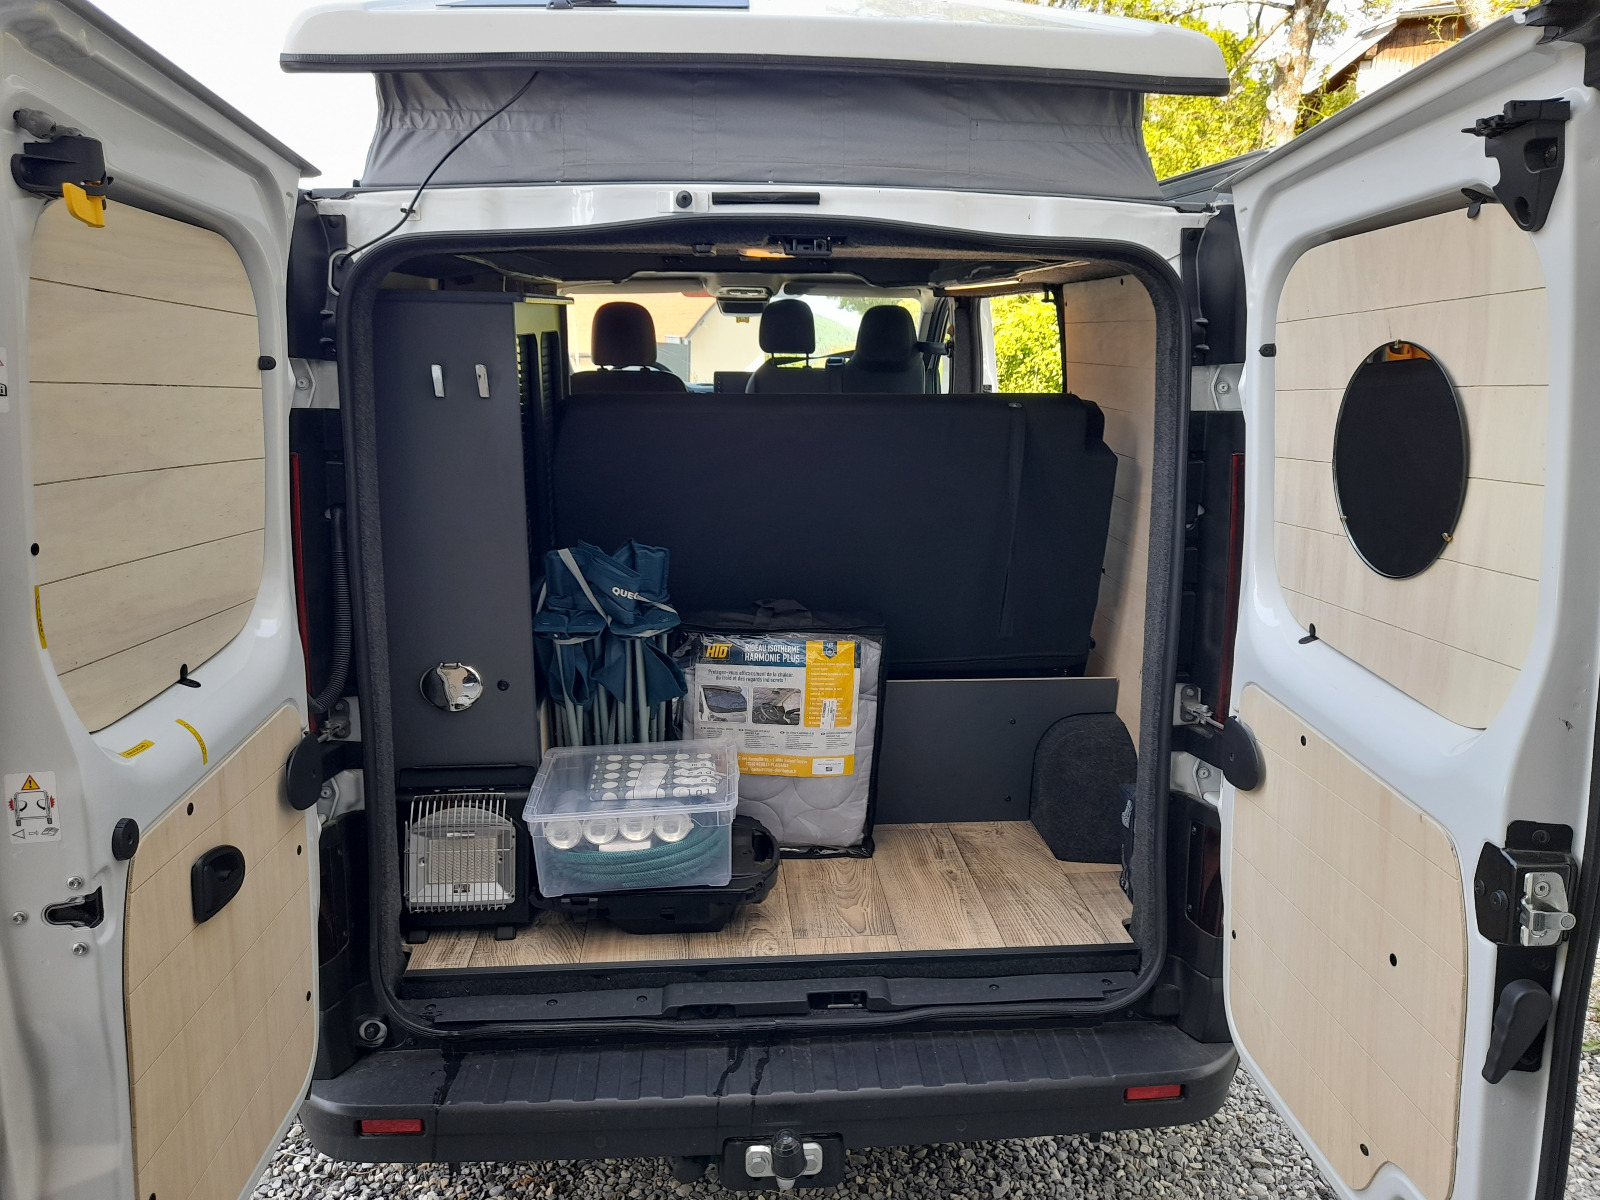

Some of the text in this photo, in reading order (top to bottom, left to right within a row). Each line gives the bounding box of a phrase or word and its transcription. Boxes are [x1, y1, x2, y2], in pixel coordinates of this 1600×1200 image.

[706, 643, 733, 659] HTD
[744, 643, 801, 654] RIDEAU ISOTHERME
[744, 652, 800, 663] HARMONIE PLUS
